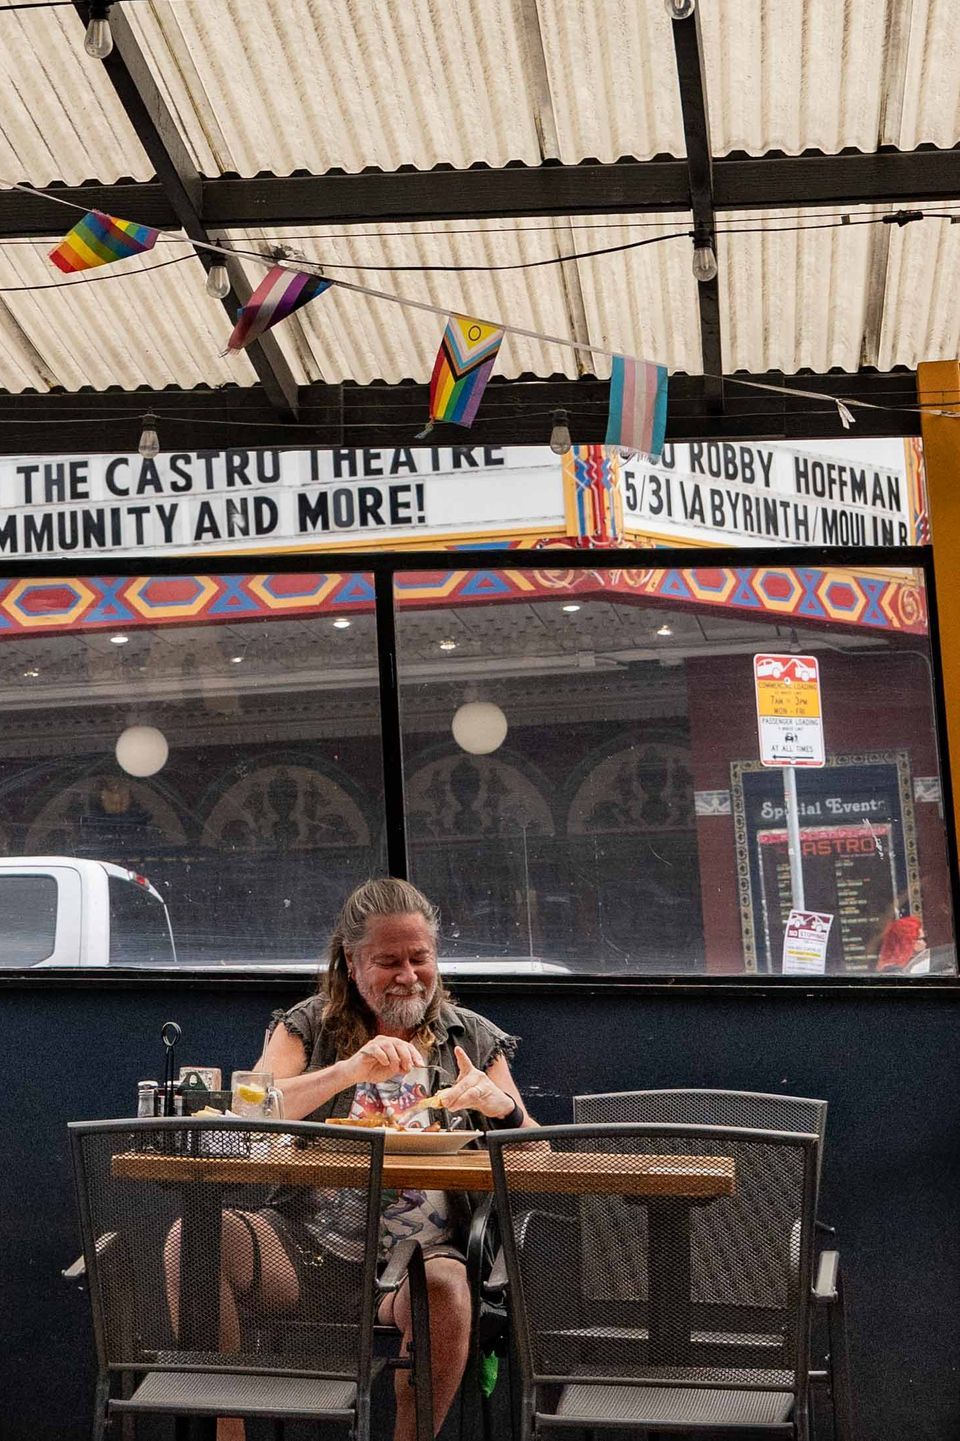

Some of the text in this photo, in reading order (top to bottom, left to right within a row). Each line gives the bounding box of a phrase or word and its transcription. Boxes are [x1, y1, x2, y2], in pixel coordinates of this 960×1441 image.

[17, 461, 89, 504] THE
[106, 449, 281, 496] CASTRO
[624, 471, 673, 518] 5/31
[690, 443, 774, 488] ROBBY
[794, 456, 902, 512] HOFFMAN
[194, 496, 279, 543] AND
[298, 482, 426, 533] MORE!
[761, 802, 822, 819] Spial
[802, 838, 875, 857] ASTRO
